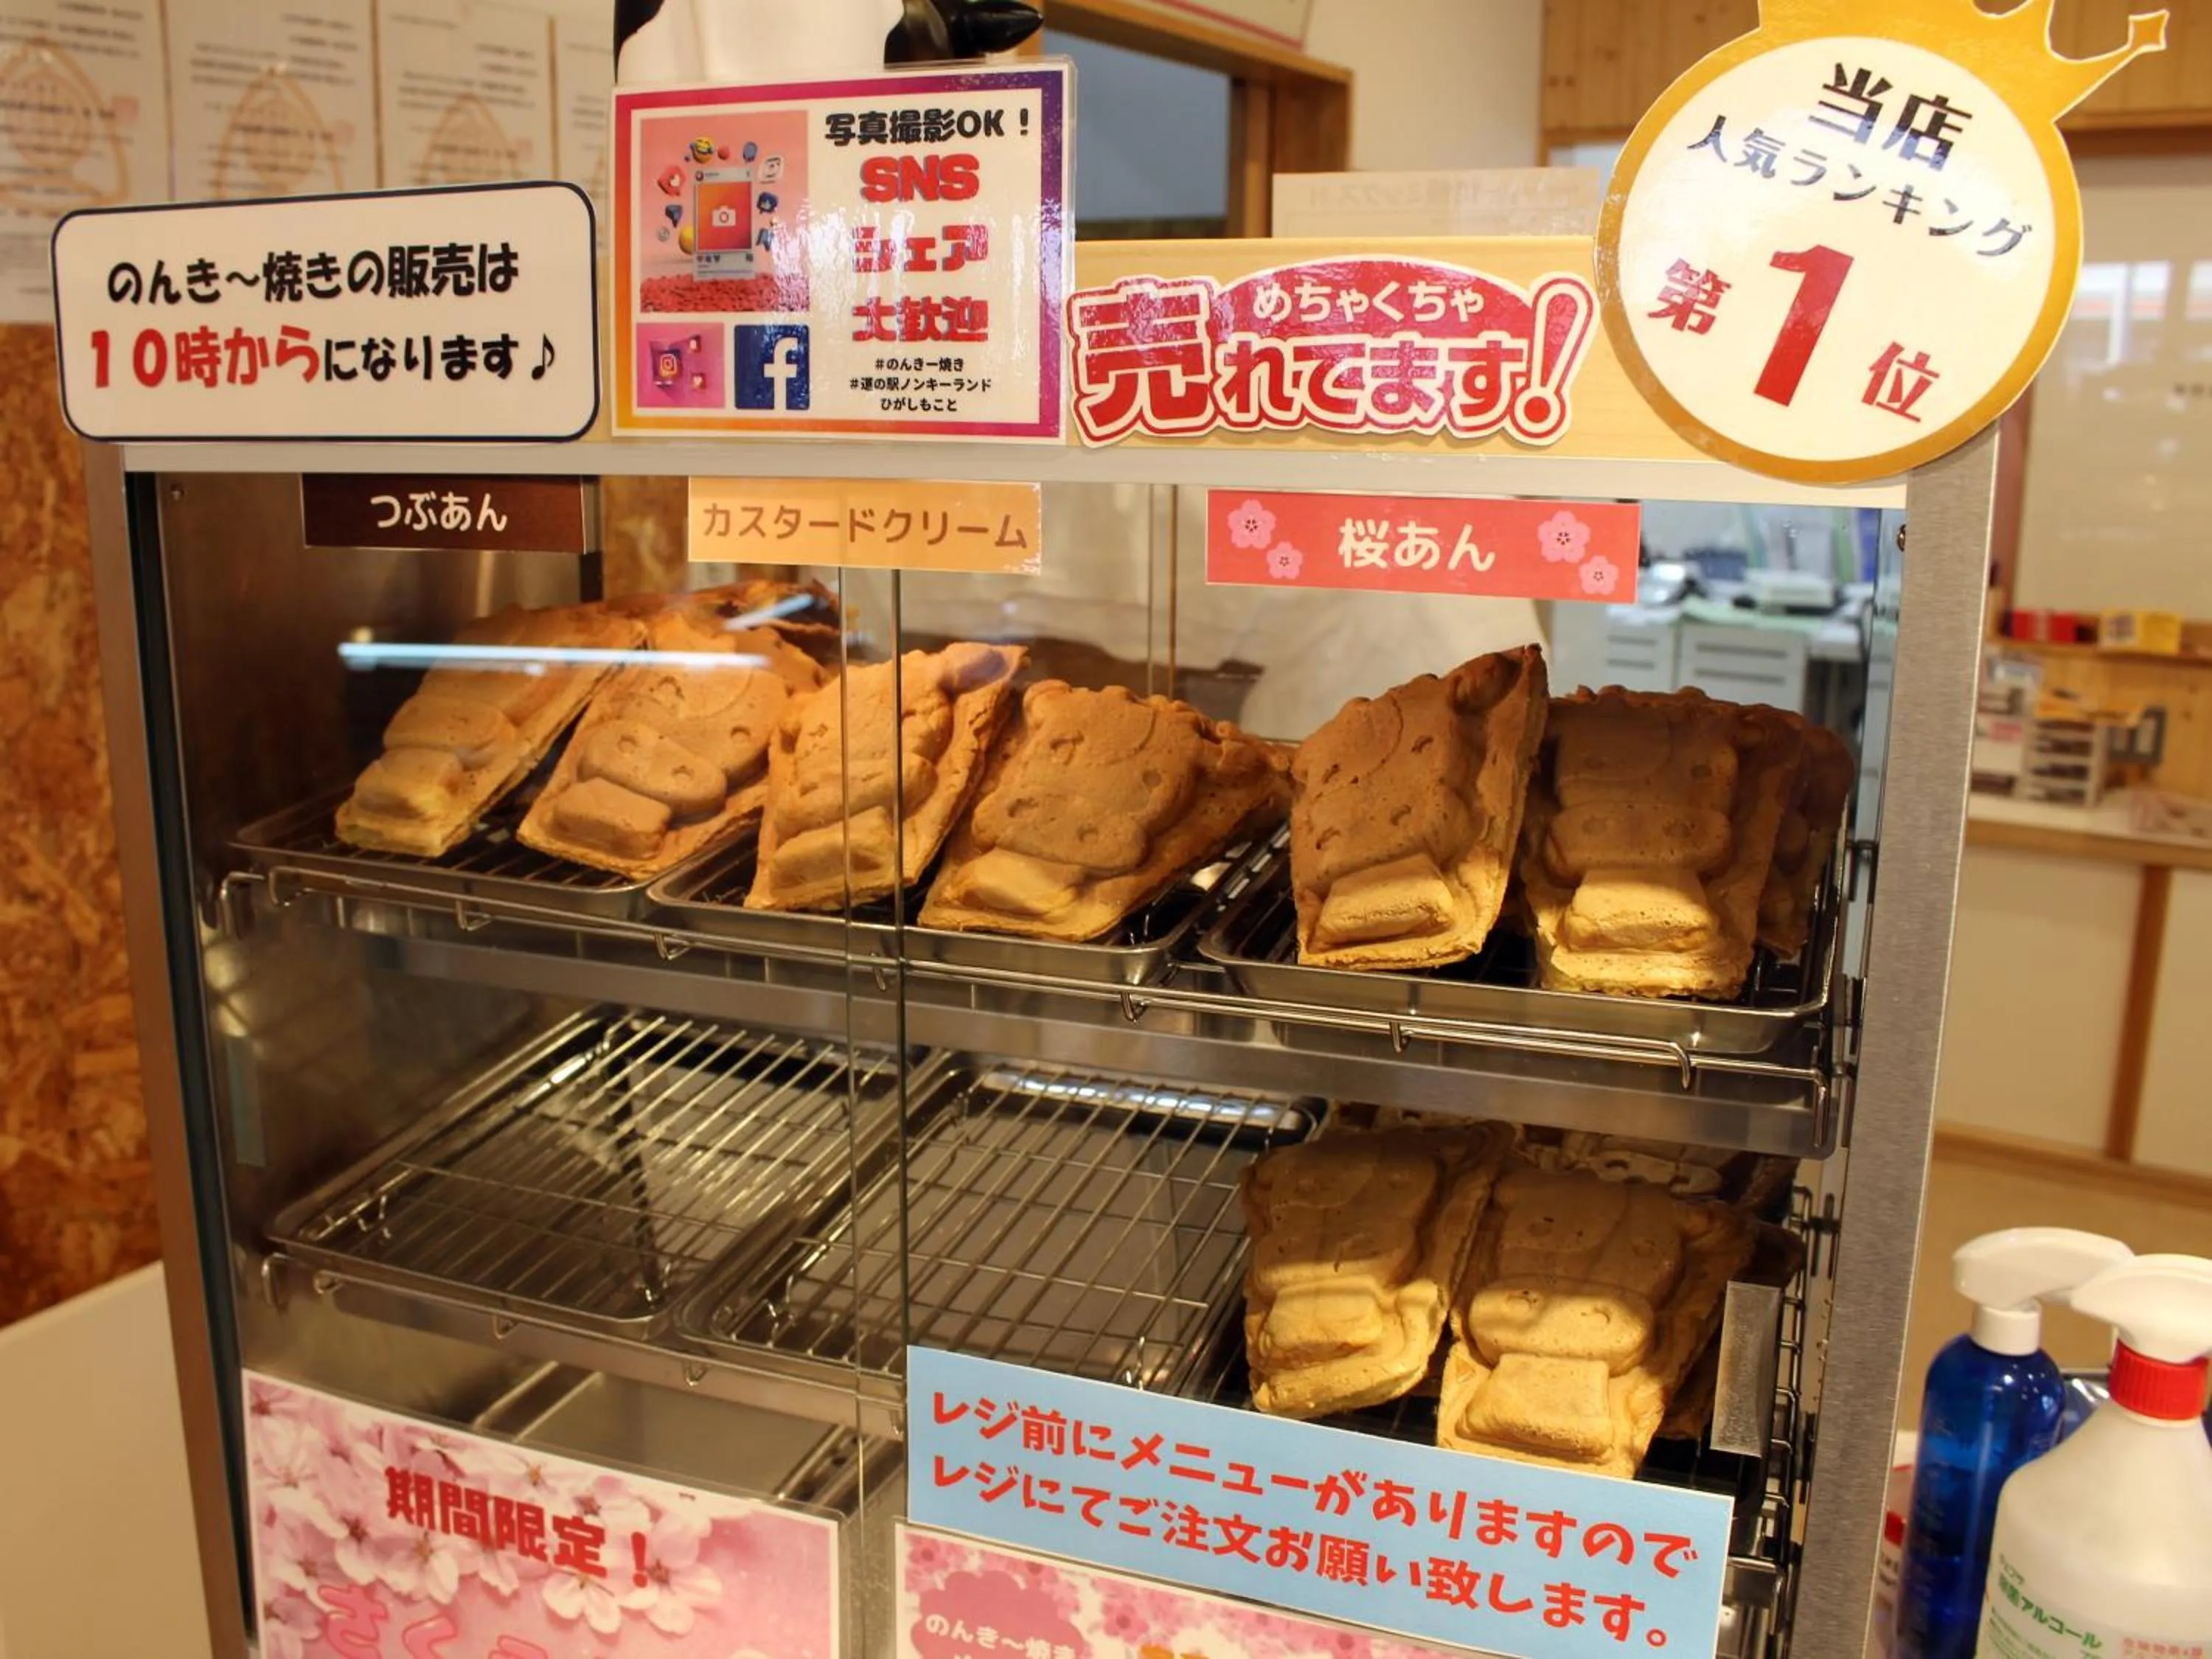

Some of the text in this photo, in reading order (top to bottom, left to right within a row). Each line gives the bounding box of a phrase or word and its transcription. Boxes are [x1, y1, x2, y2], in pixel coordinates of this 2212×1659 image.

[825, 108, 1029, 146] 写真撮影OK！
[1808, 62, 1973, 172] 当店
[860, 153, 981, 204] SNS
[1687, 114, 2034, 257] 人気ランキング
[108, 243, 520, 305] のんき～焼きの販売は
[852, 223, 989, 273] シェア
[852, 296, 989, 343] 大歓迎
[1253, 282, 1484, 323] めちゃくちゃ
[1077, 283, 1588, 428] 売れてます！
[880, 397, 957, 411] ひがしもこと
[370, 492, 509, 532] つぶあん
[702, 503, 1029, 550] カスタードクリーム
[1337, 518, 1495, 572] 桜あん
[933, 1391, 1698, 1579] レジ前にメニューがありますので
[384, 1466, 650, 1588] 期間限定！
[933, 1455, 1668, 1647] レジにてご注文お願い致します。
